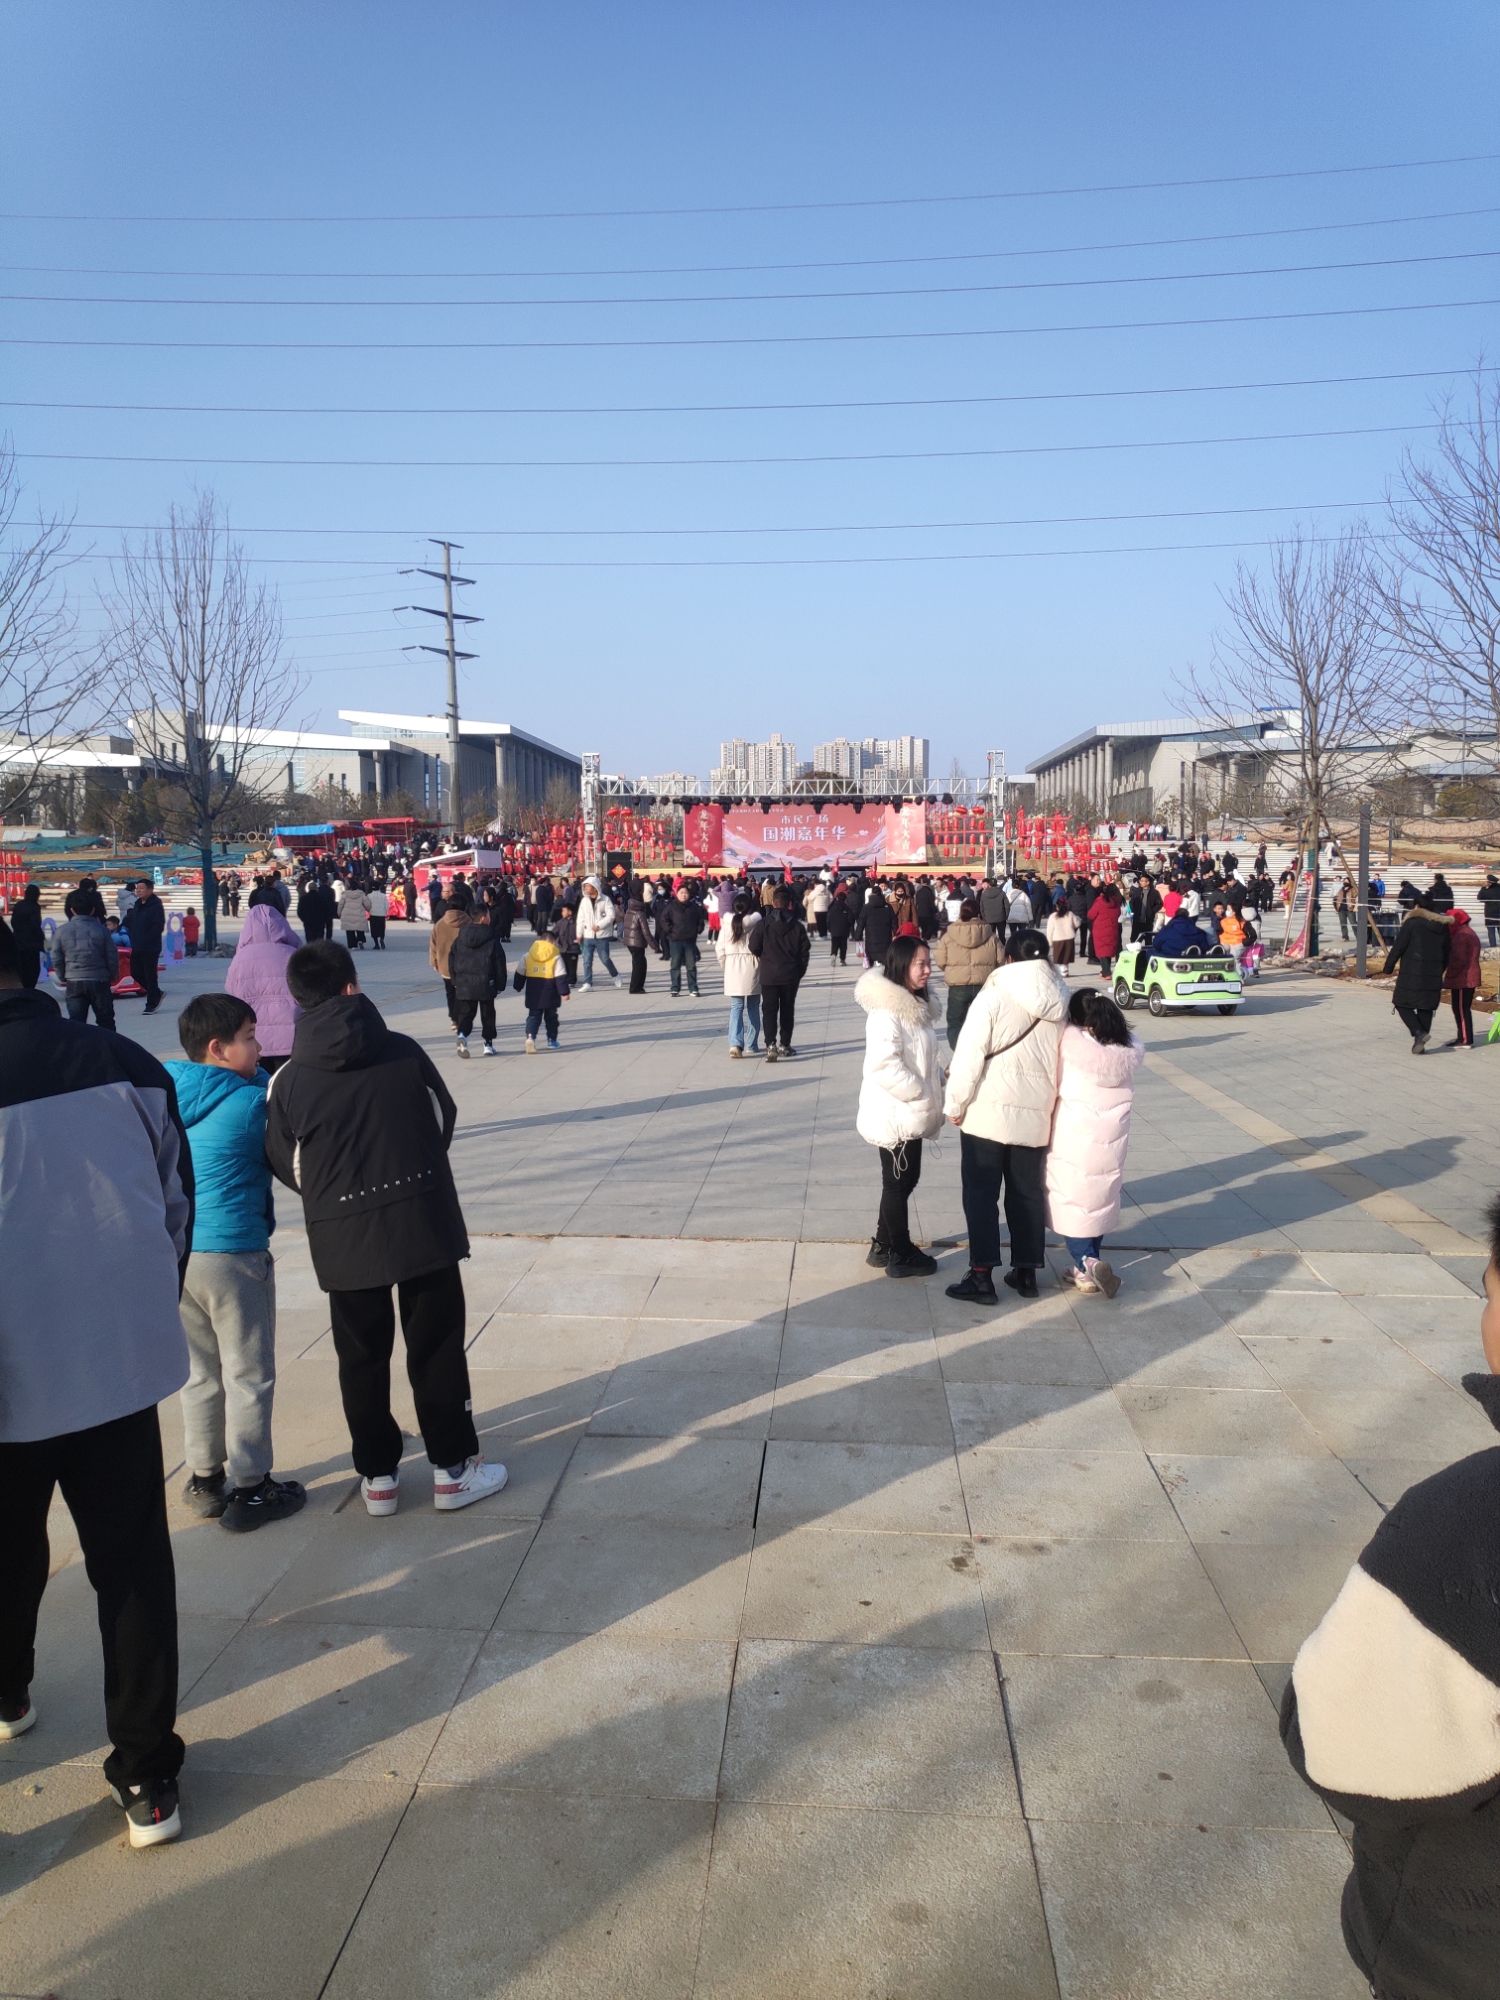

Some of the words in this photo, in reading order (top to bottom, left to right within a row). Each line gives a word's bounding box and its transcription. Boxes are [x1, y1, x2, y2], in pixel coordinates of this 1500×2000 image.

[781, 815, 829, 825] 市民广场
[763, 825, 846, 842] 国潮嘉年华
